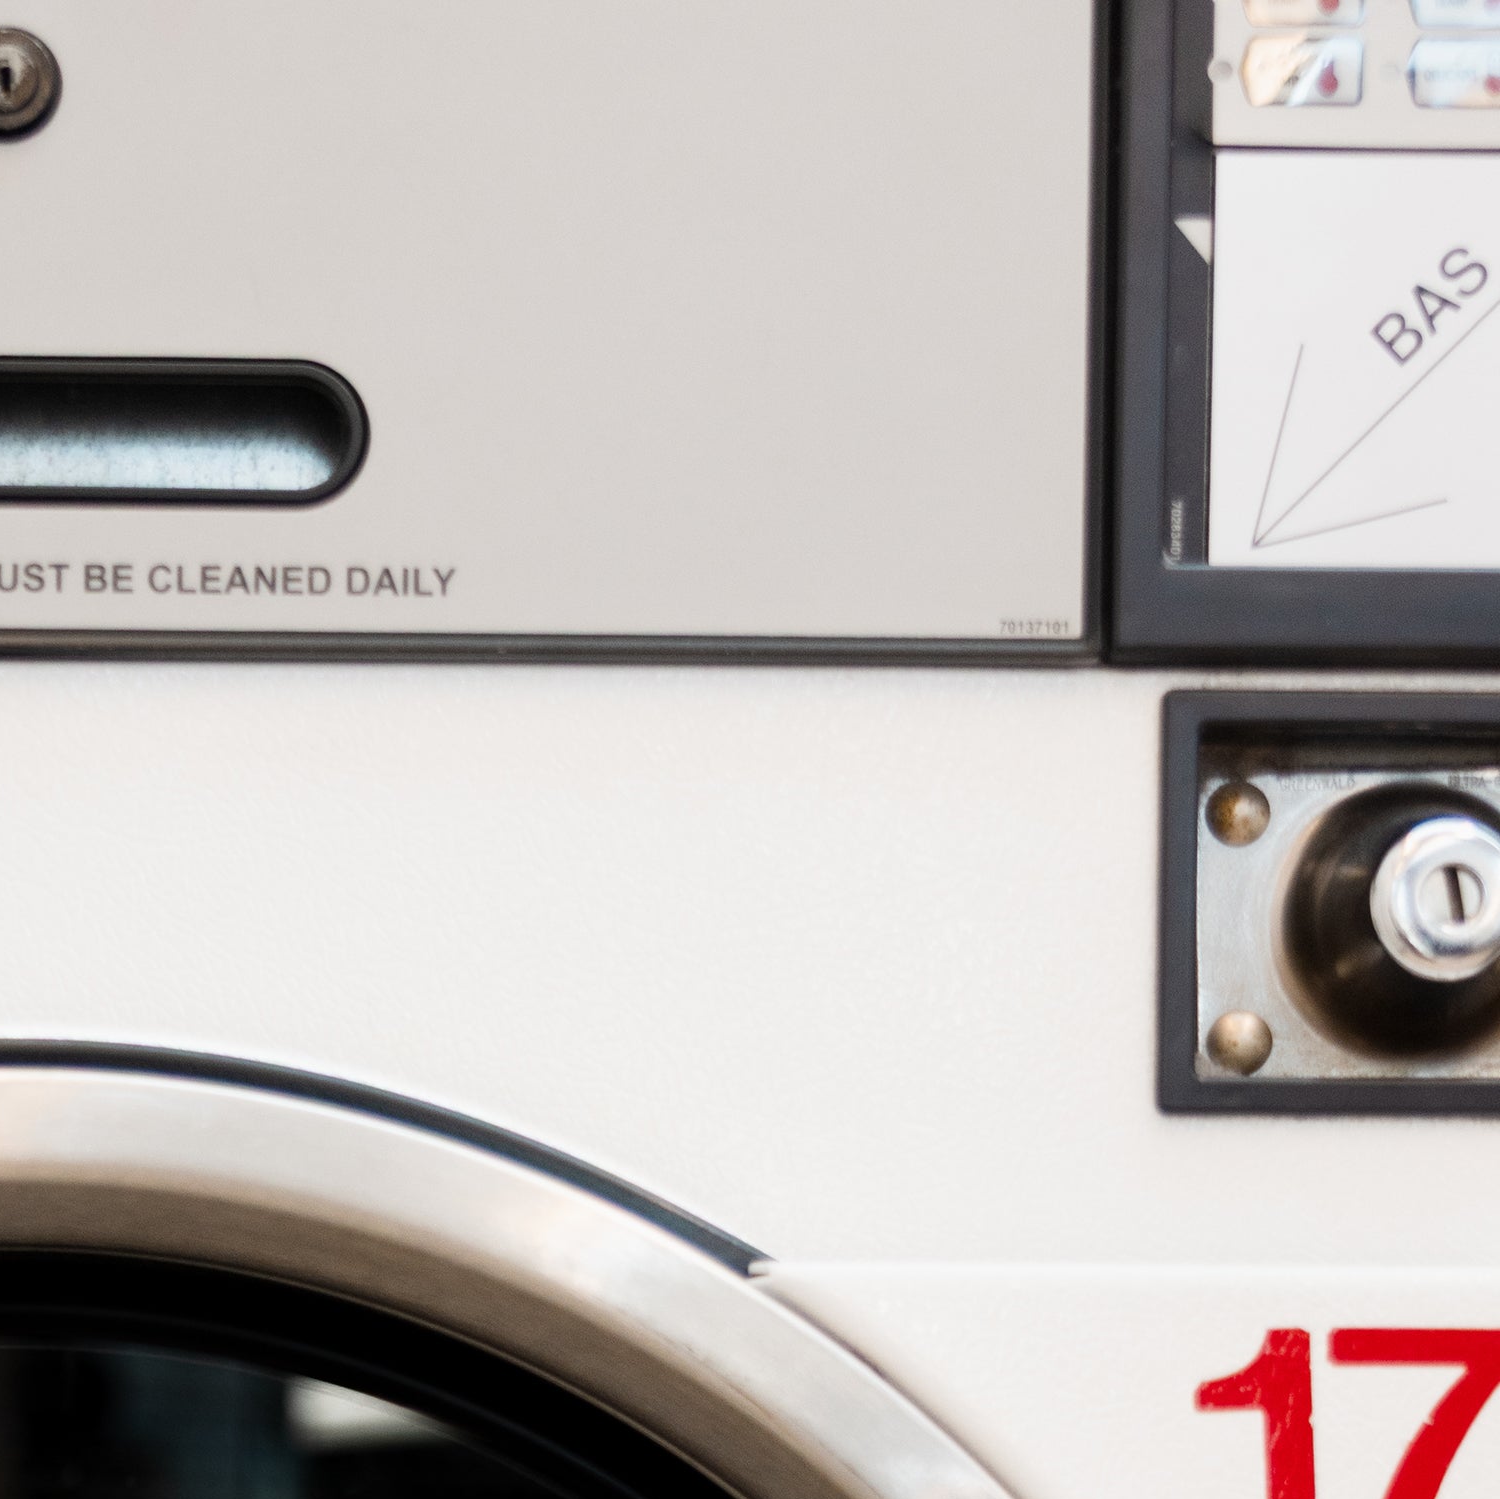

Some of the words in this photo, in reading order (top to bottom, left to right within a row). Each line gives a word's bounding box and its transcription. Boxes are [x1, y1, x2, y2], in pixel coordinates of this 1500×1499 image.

[1371, 247, 1489, 365] BAS
[83, 562, 134, 594] BE
[147, 563, 332, 595] CLEANED
[346, 566, 456, 597] DAILY
